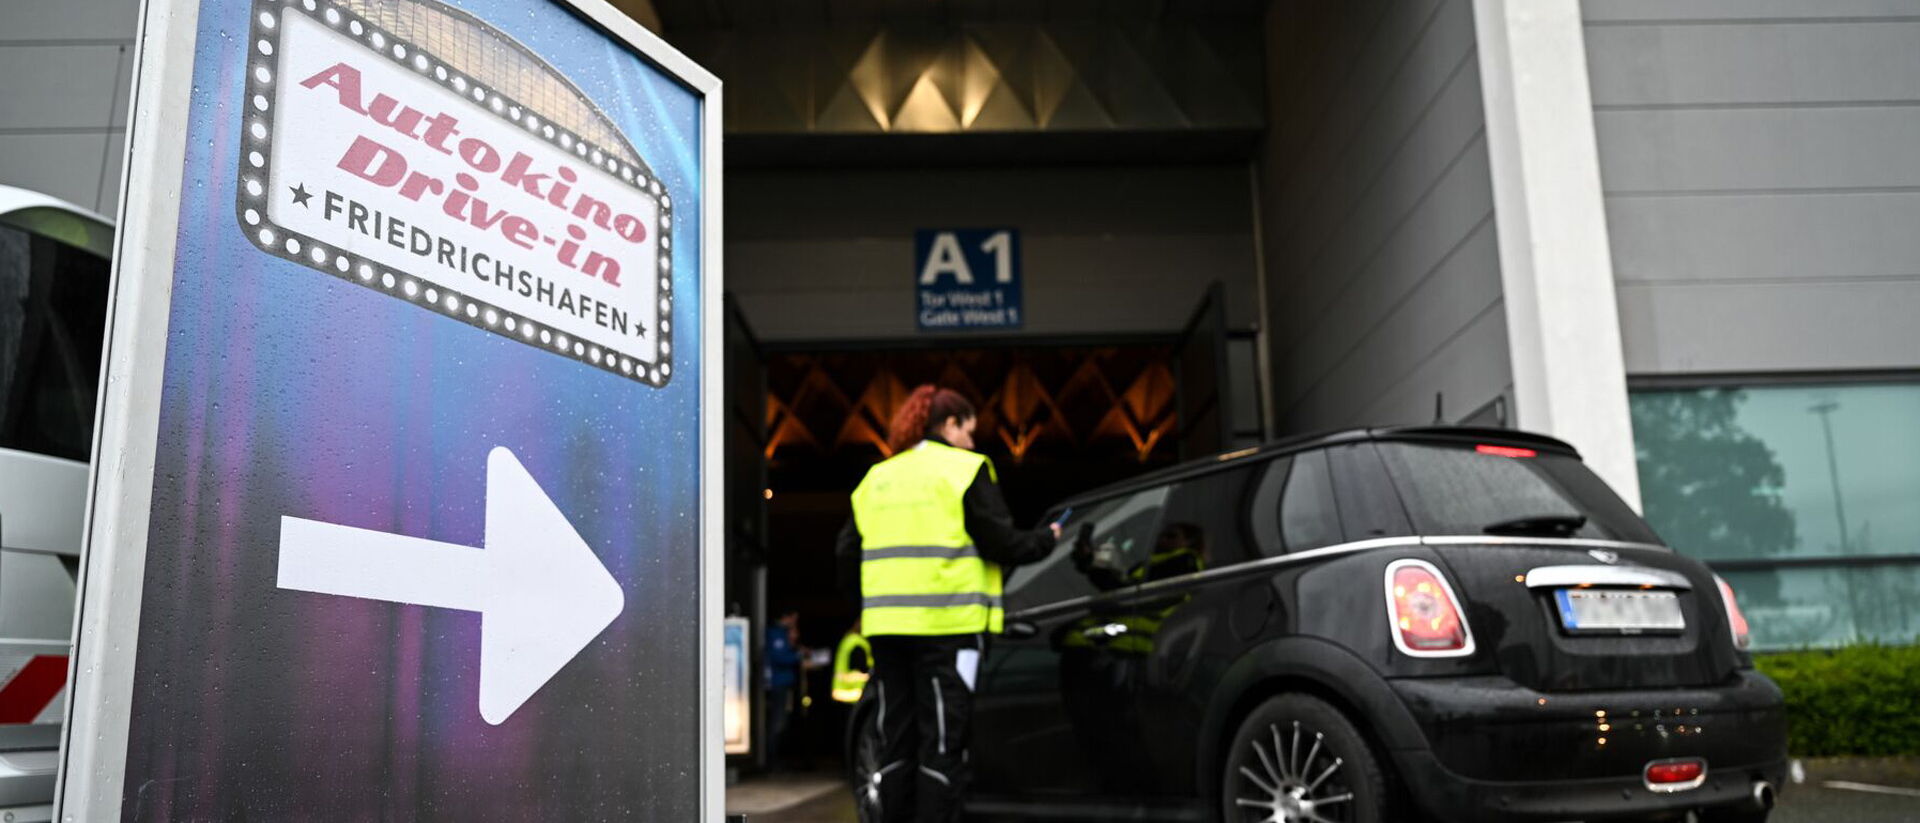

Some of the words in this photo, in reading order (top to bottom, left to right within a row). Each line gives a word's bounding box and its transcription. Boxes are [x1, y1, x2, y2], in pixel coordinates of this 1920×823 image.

[299, 61, 648, 245] Autokino
[335, 134, 622, 288] Drive-in
[323, 189, 629, 336] FRIEDRICHSHAFEN
[920, 309, 959, 326] Gate
[962, 308, 1005, 325] West
[1008, 307, 1018, 324] 1
[922, 291, 946, 307] Tor
[947, 290, 991, 307] West
[995, 290, 1004, 306] 1
